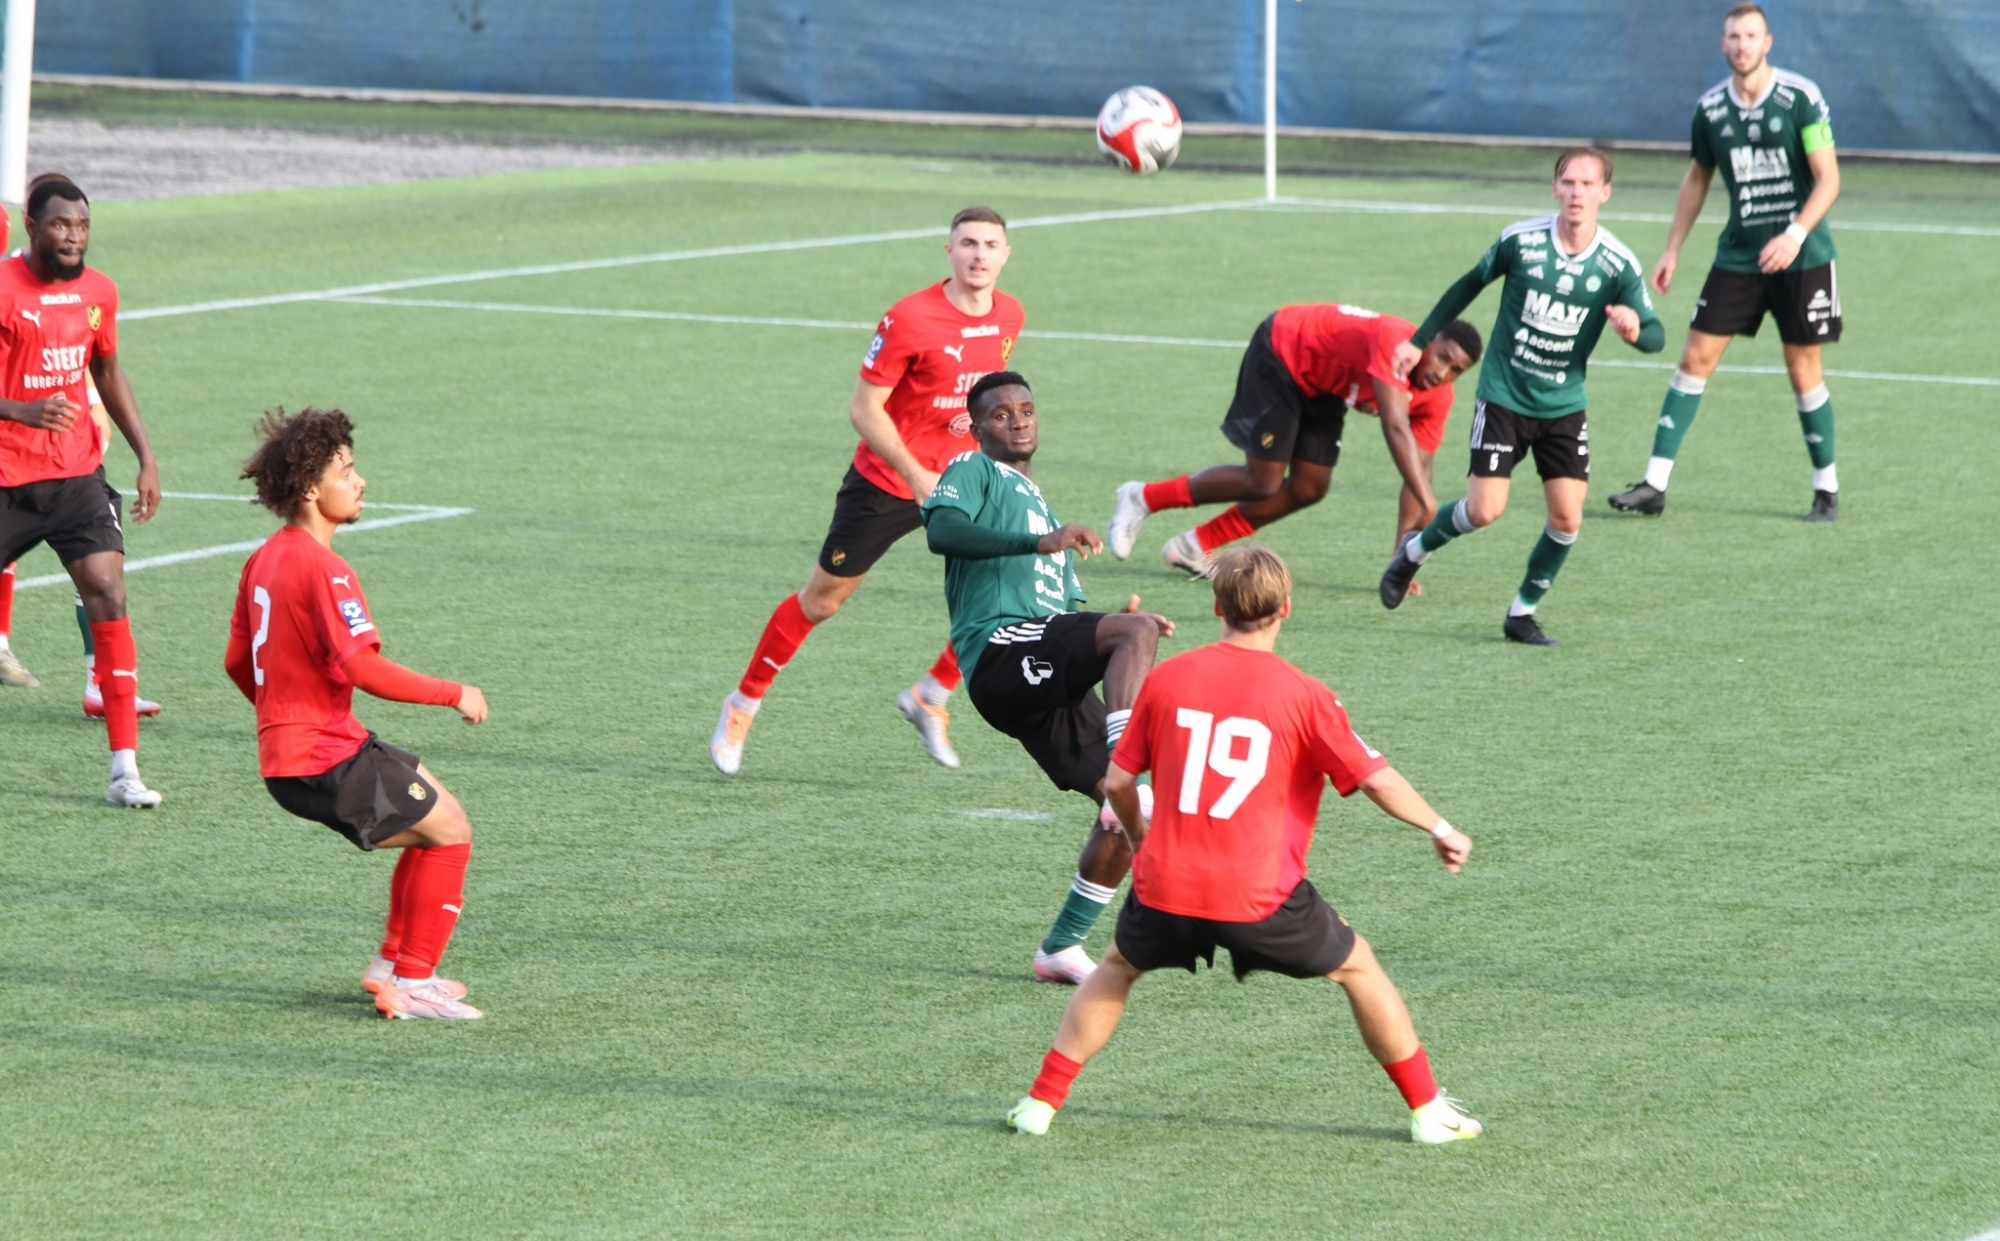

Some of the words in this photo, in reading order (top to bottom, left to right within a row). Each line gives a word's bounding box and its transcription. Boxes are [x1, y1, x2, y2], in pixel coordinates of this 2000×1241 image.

[1730, 146, 1789, 171] MAXI
[1523, 288, 1590, 325] MAXI
[42, 345, 86, 372] STEKT
[23, 373, 64, 389] BURGER
[251, 585, 271, 686] 2
[1176, 707, 1272, 820] 19
